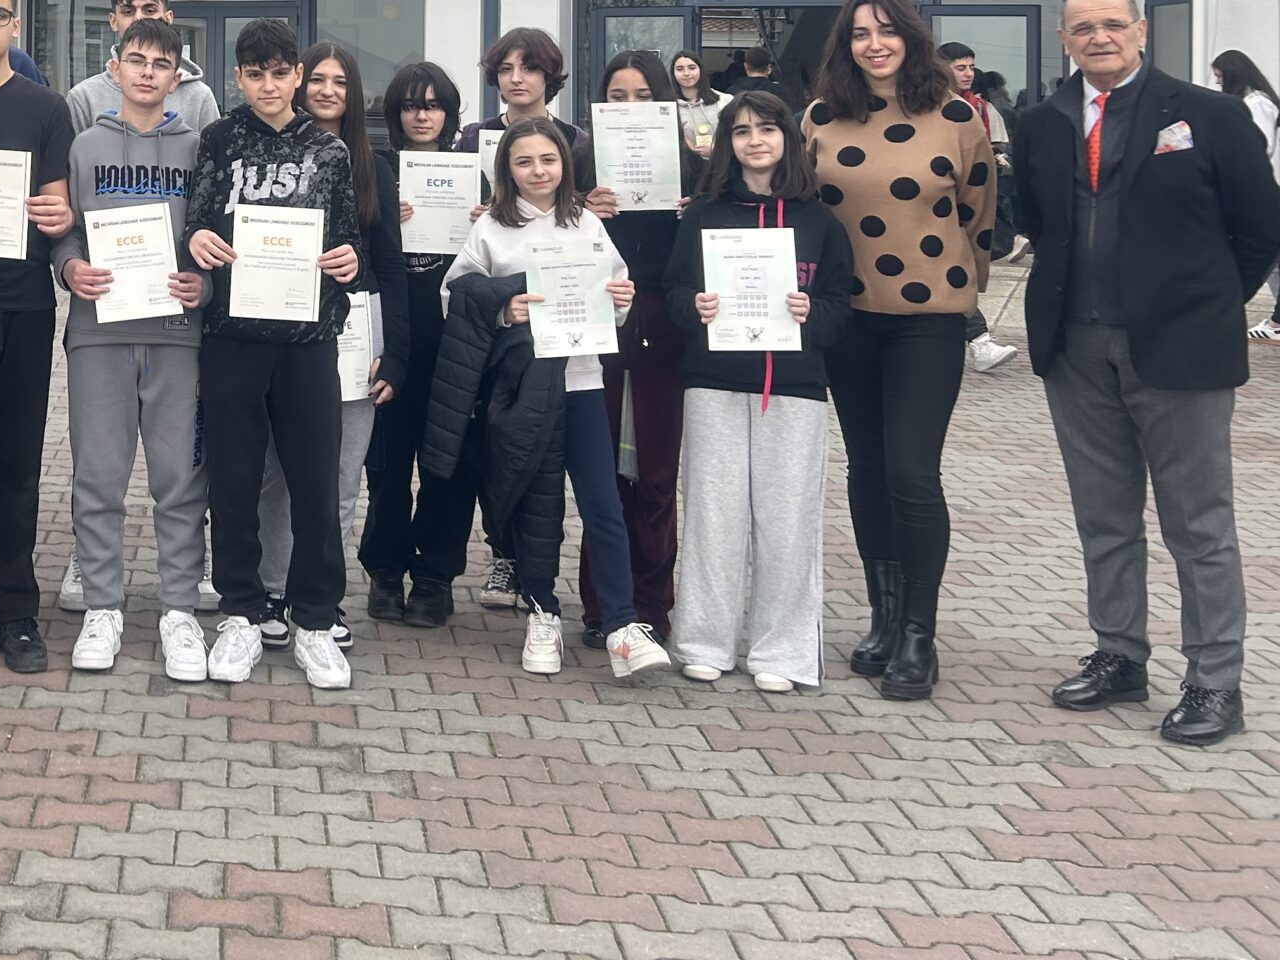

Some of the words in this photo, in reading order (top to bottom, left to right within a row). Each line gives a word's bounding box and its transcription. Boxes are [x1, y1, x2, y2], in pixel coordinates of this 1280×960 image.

[426, 178, 454, 188] ECPE
[116, 234, 145, 246] ECCE
[262, 236, 293, 247] ECCE
